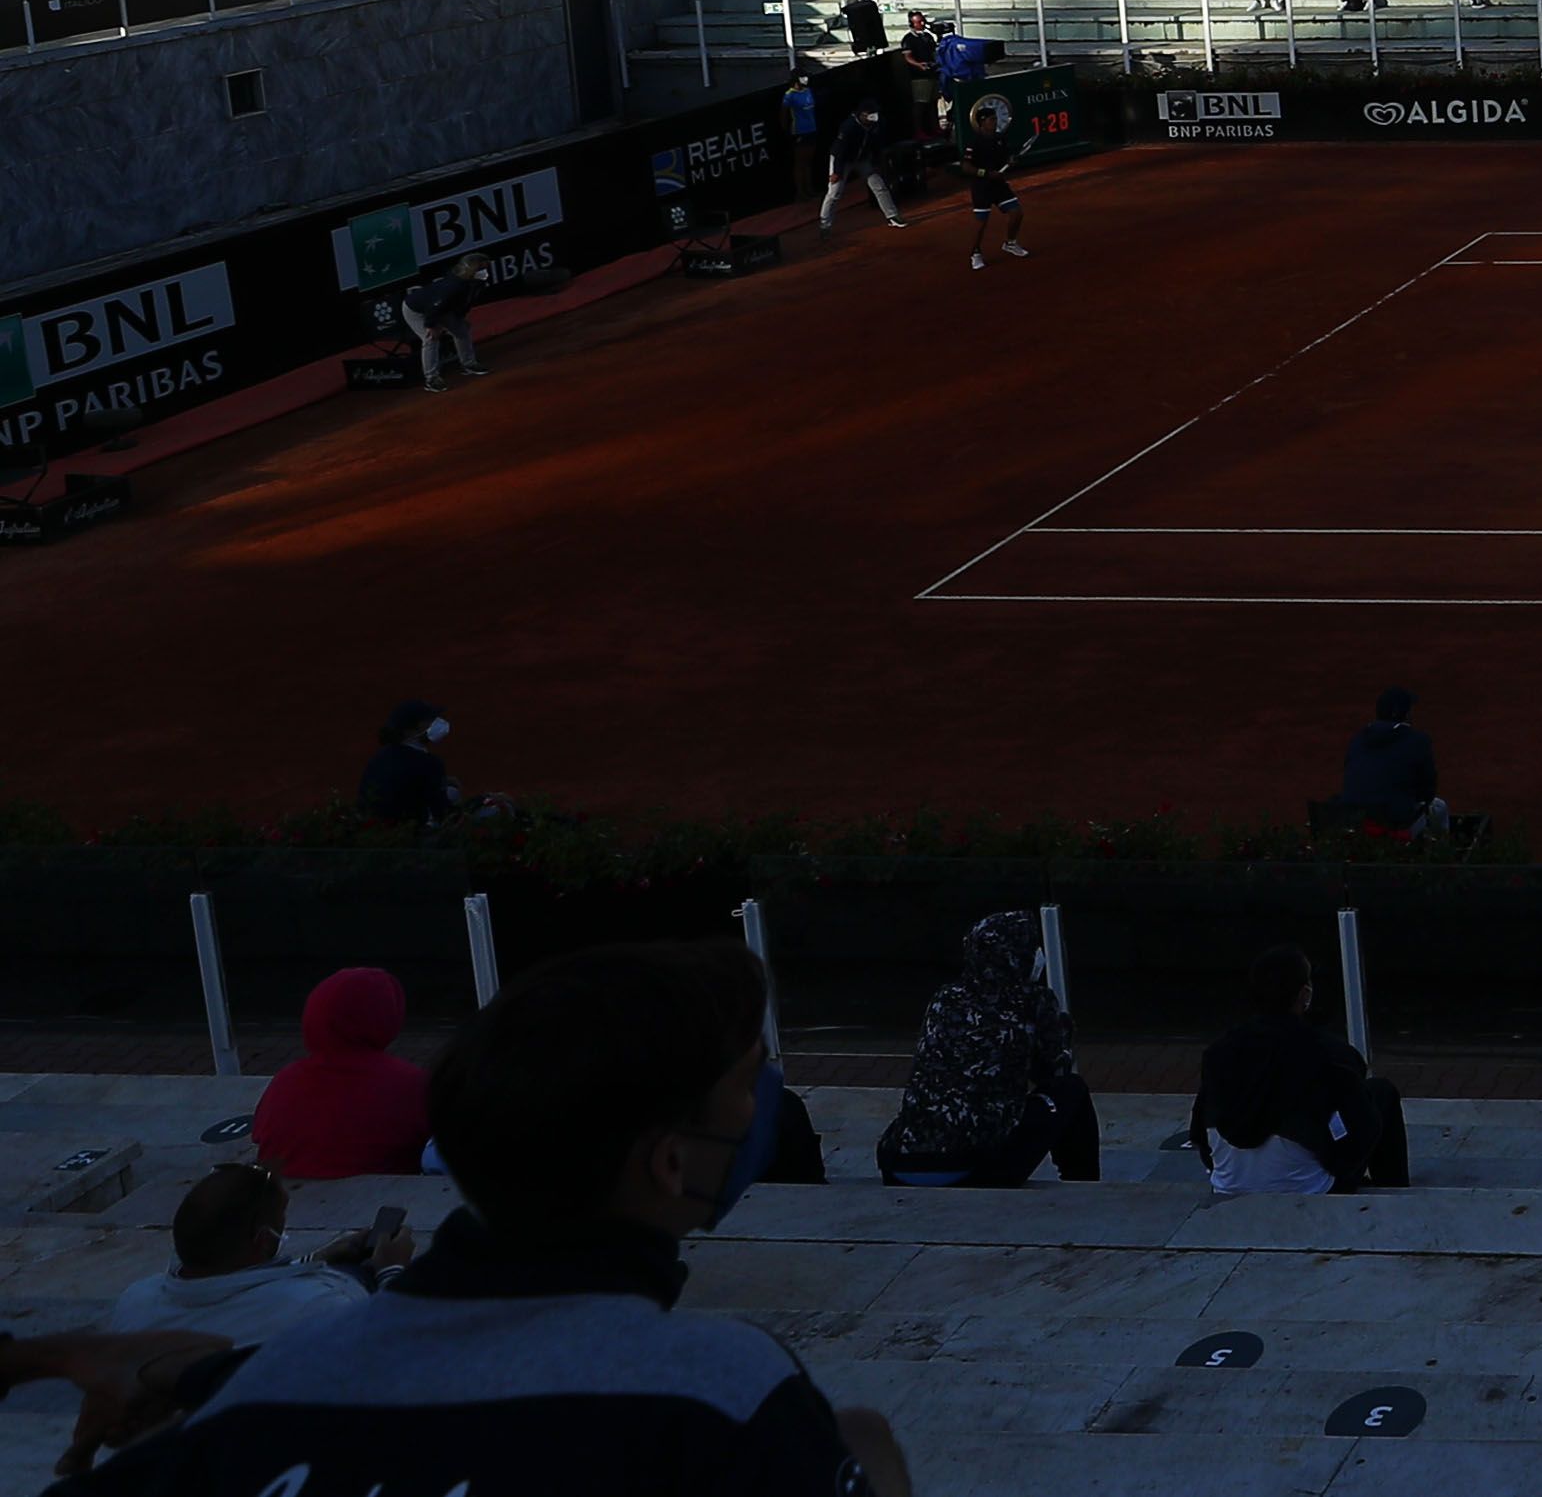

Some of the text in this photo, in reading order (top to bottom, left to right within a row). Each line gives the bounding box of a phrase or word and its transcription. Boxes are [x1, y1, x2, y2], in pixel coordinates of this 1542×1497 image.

[1026, 88, 1069, 104] ROLEX
[1203, 94, 1272, 116] BNL
[1030, 110, 1070, 135] 1:28
[1406, 99, 1527, 125] ALGIDA
[688, 121, 767, 165] REALE
[1168, 124, 1275, 138] BNP PARIBAS
[690, 148, 770, 184] MUTUA
[422, 183, 547, 255] BNL
[40, 282, 214, 375] BNL
[55, 349, 224, 432] PARIBAS
[1203, 1348, 1233, 1367] 5
[1363, 1404, 1394, 1428] 3
